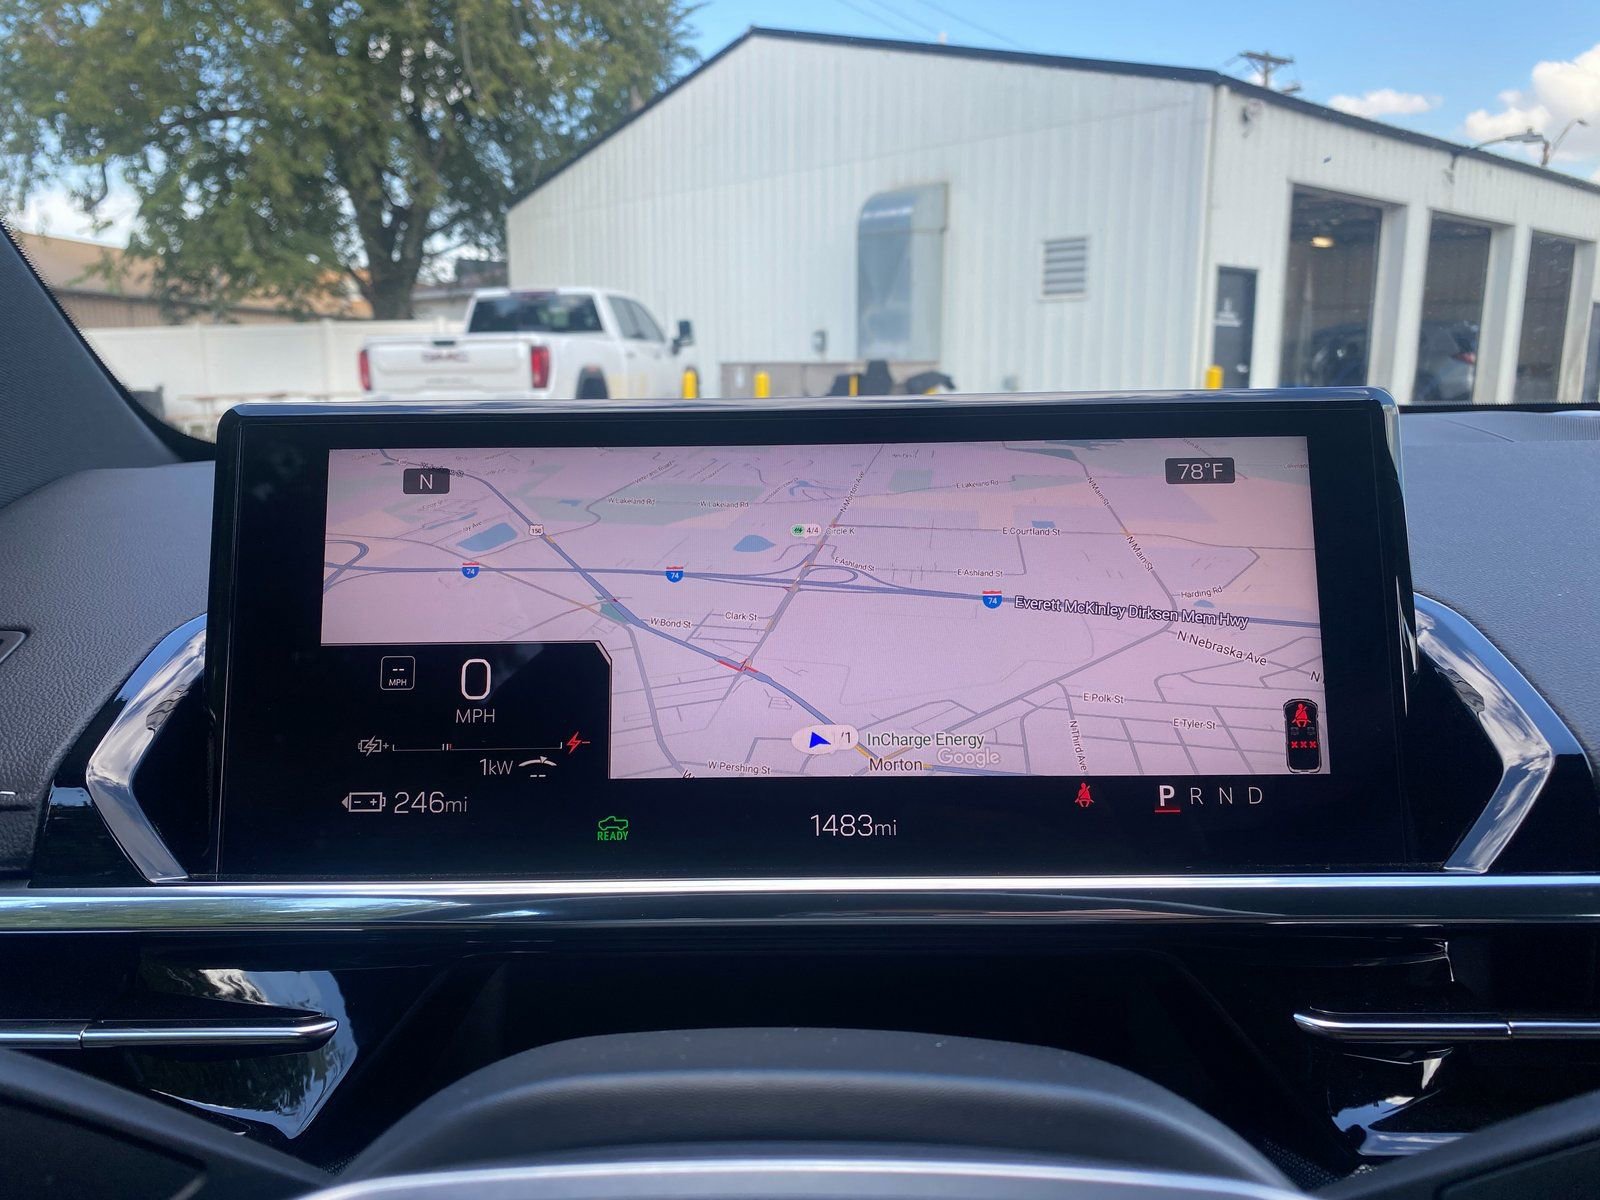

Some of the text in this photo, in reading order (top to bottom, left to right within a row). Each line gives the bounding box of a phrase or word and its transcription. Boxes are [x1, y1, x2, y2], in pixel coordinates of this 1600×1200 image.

[1177, 462, 1223, 480] 78°F
[419, 473, 433, 490] N
[843, 483, 859, 508] Morton
[855, 471, 865, 485] Ave
[1092, 483, 1104, 498] Main
[1103, 497, 1110, 506] St
[1010, 527, 1050, 536] Courtland
[1127, 536, 1153, 572] N Main St
[839, 558, 867, 570] Ashland
[963, 569, 994, 577] Ashland
[1181, 586, 1222, 598] Harding Rd
[988, 597, 997, 605] 74
[725, 612, 757, 621] Clark St
[1015, 595, 1249, 630] Everett McKinley Dirksen Mem Hwy
[661, 619, 681, 627] Bond
[683, 620, 691, 628] St
[1177, 631, 1267, 666] N Nebraska Ave
[388, 678, 407, 687] MPH
[460, 658, 492, 701] 0
[1083, 693, 1124, 703] E Polk St
[455, 708, 495, 724] MPH
[1173, 718, 1216, 730] E Tyler St
[867, 733, 984, 749] InCharge Energy
[1069, 720, 1087, 771] N Third Ave
[869, 757, 923, 771] Morton
[937, 748, 1000, 767] Google
[479, 758, 513, 776] 1kW
[719, 762, 759, 775] Pershing
[761, 766, 771, 775] St
[1159, 785, 1263, 807] P R N D
[597, 831, 629, 841] READY
